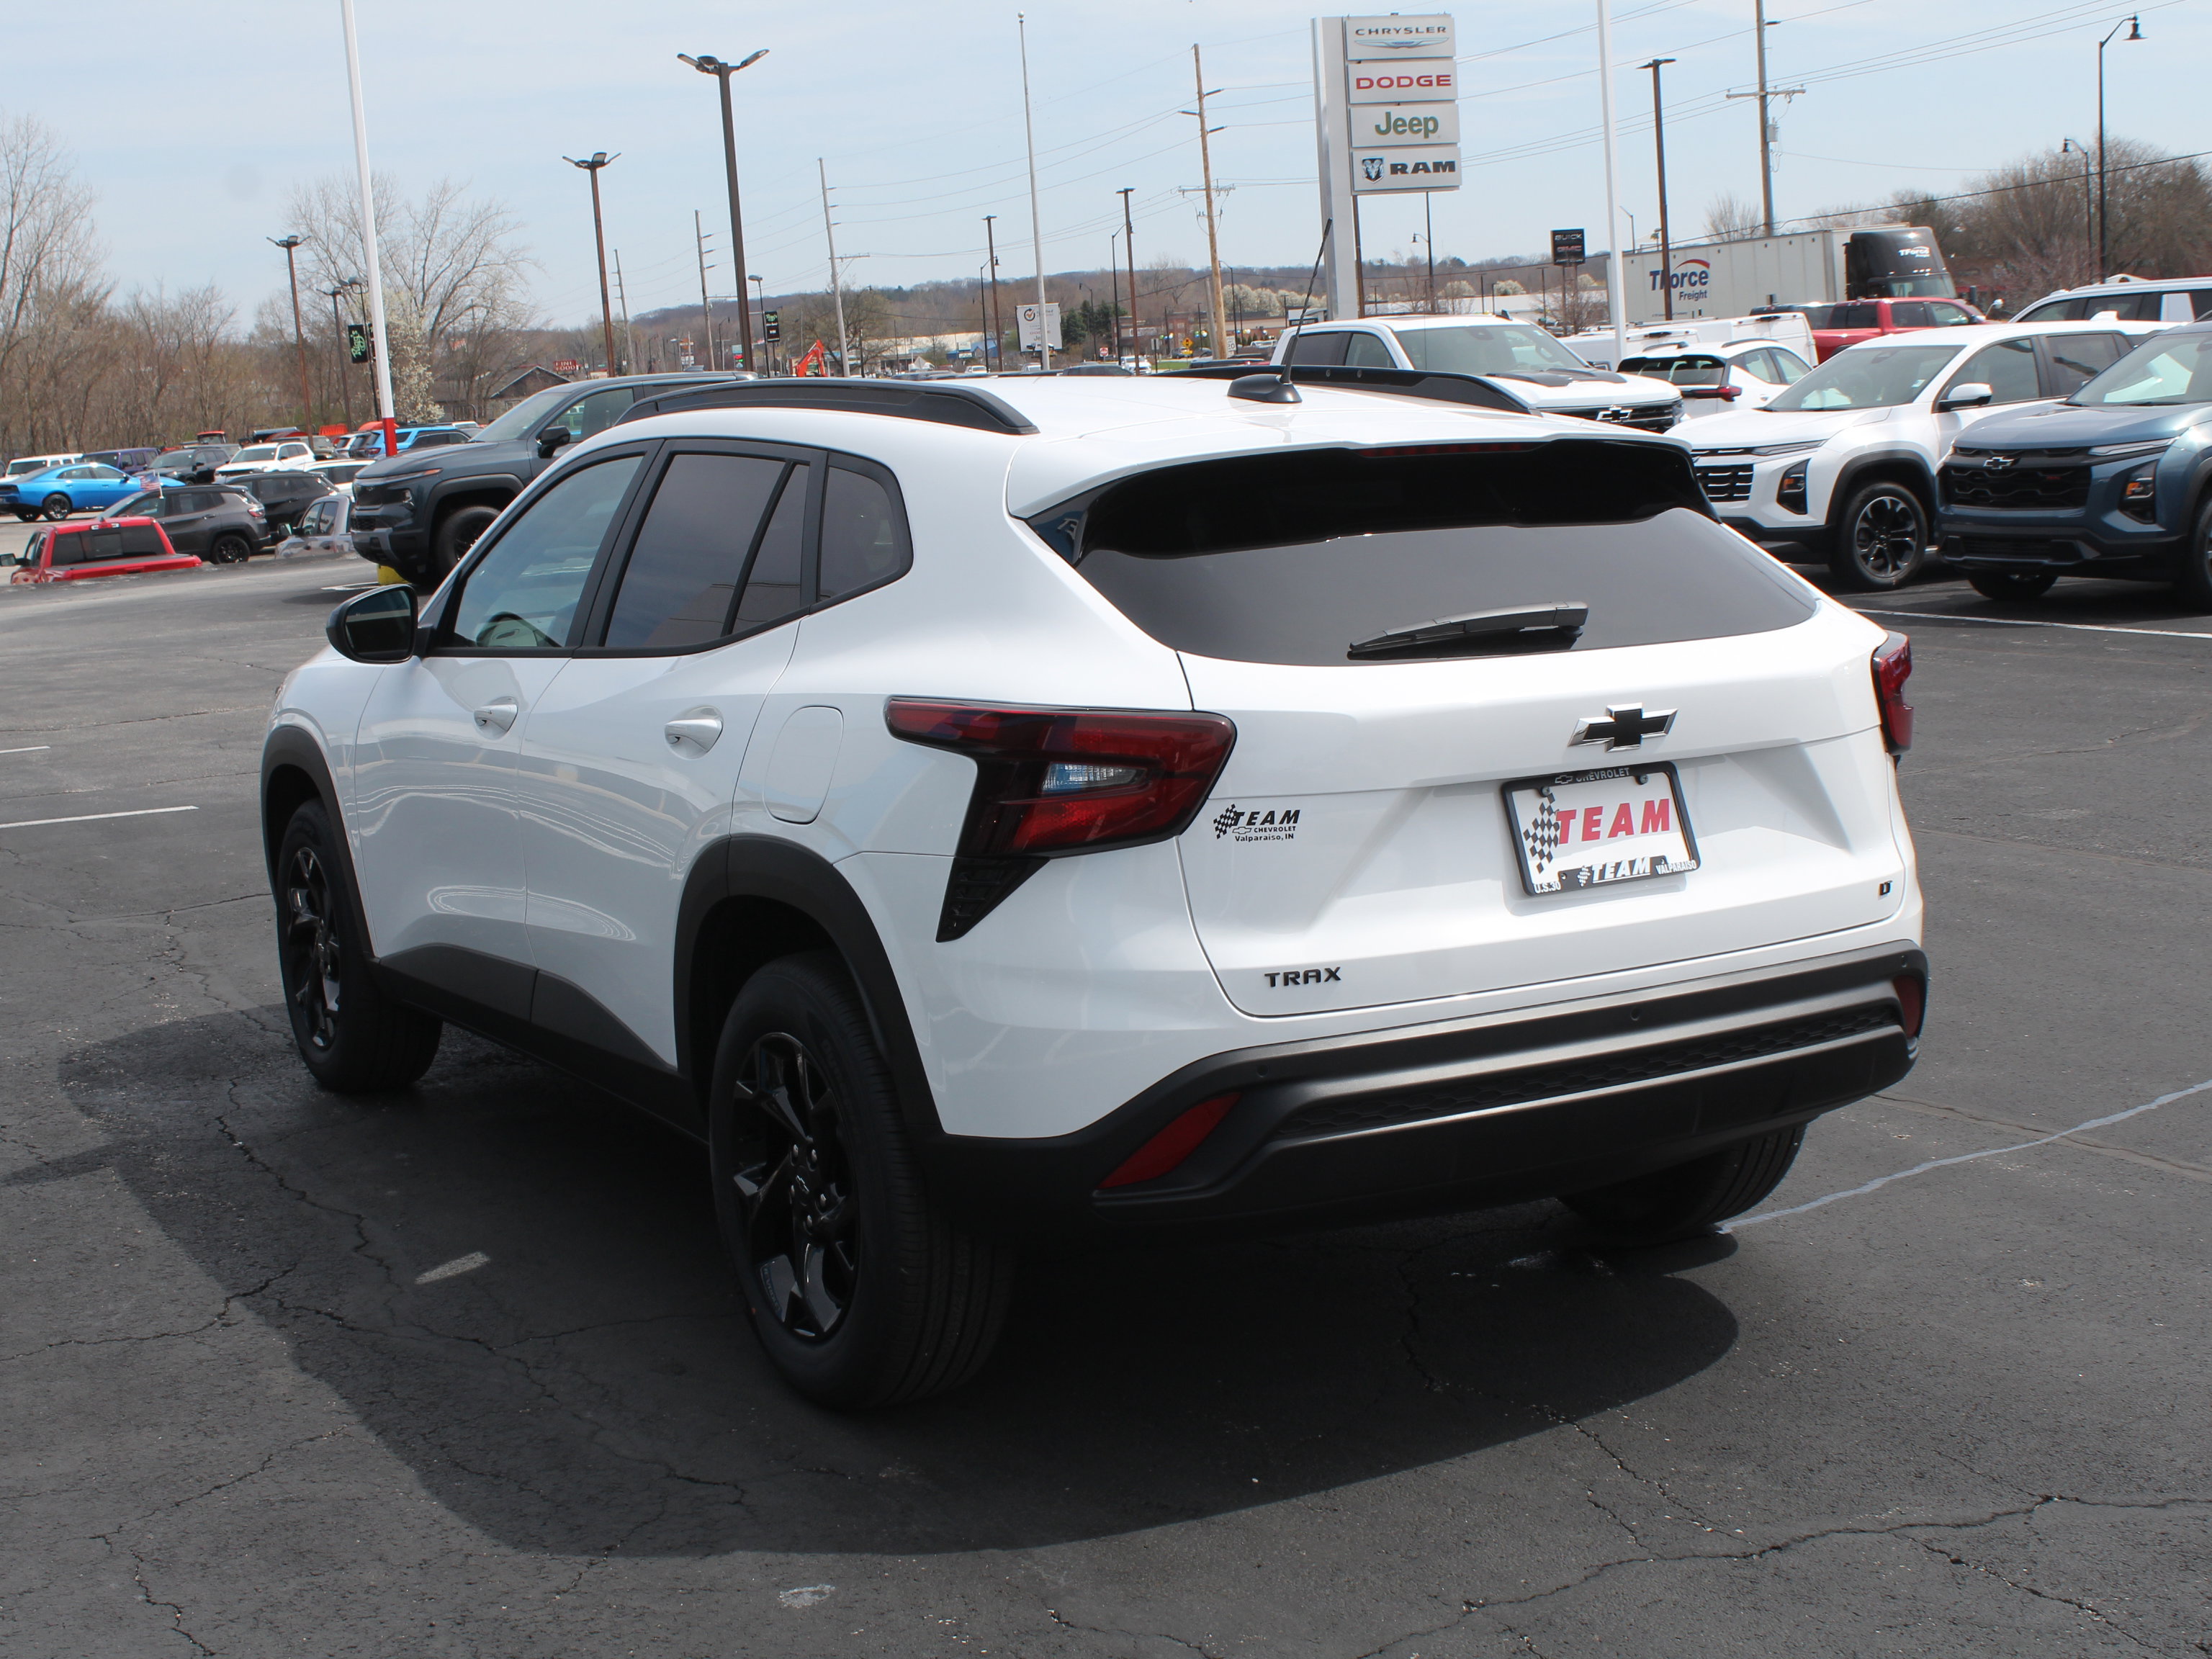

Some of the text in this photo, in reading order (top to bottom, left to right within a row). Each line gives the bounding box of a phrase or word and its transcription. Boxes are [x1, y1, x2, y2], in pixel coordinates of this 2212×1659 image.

[1354, 26, 1447, 36] CHRYSLER
[1356, 74, 1452, 90] DODGE
[1374, 111, 1439, 139] Jeep
[1390, 161, 1456, 175] RAM
[1678, 289, 1708, 302] Freight
[1232, 809, 1300, 827] TEAM
[1555, 798, 1671, 845] TEAM
[1591, 857, 1651, 882] TEAM
[1656, 859, 1697, 876] VALPARAISO
[1264, 966, 1341, 988] TRAX
